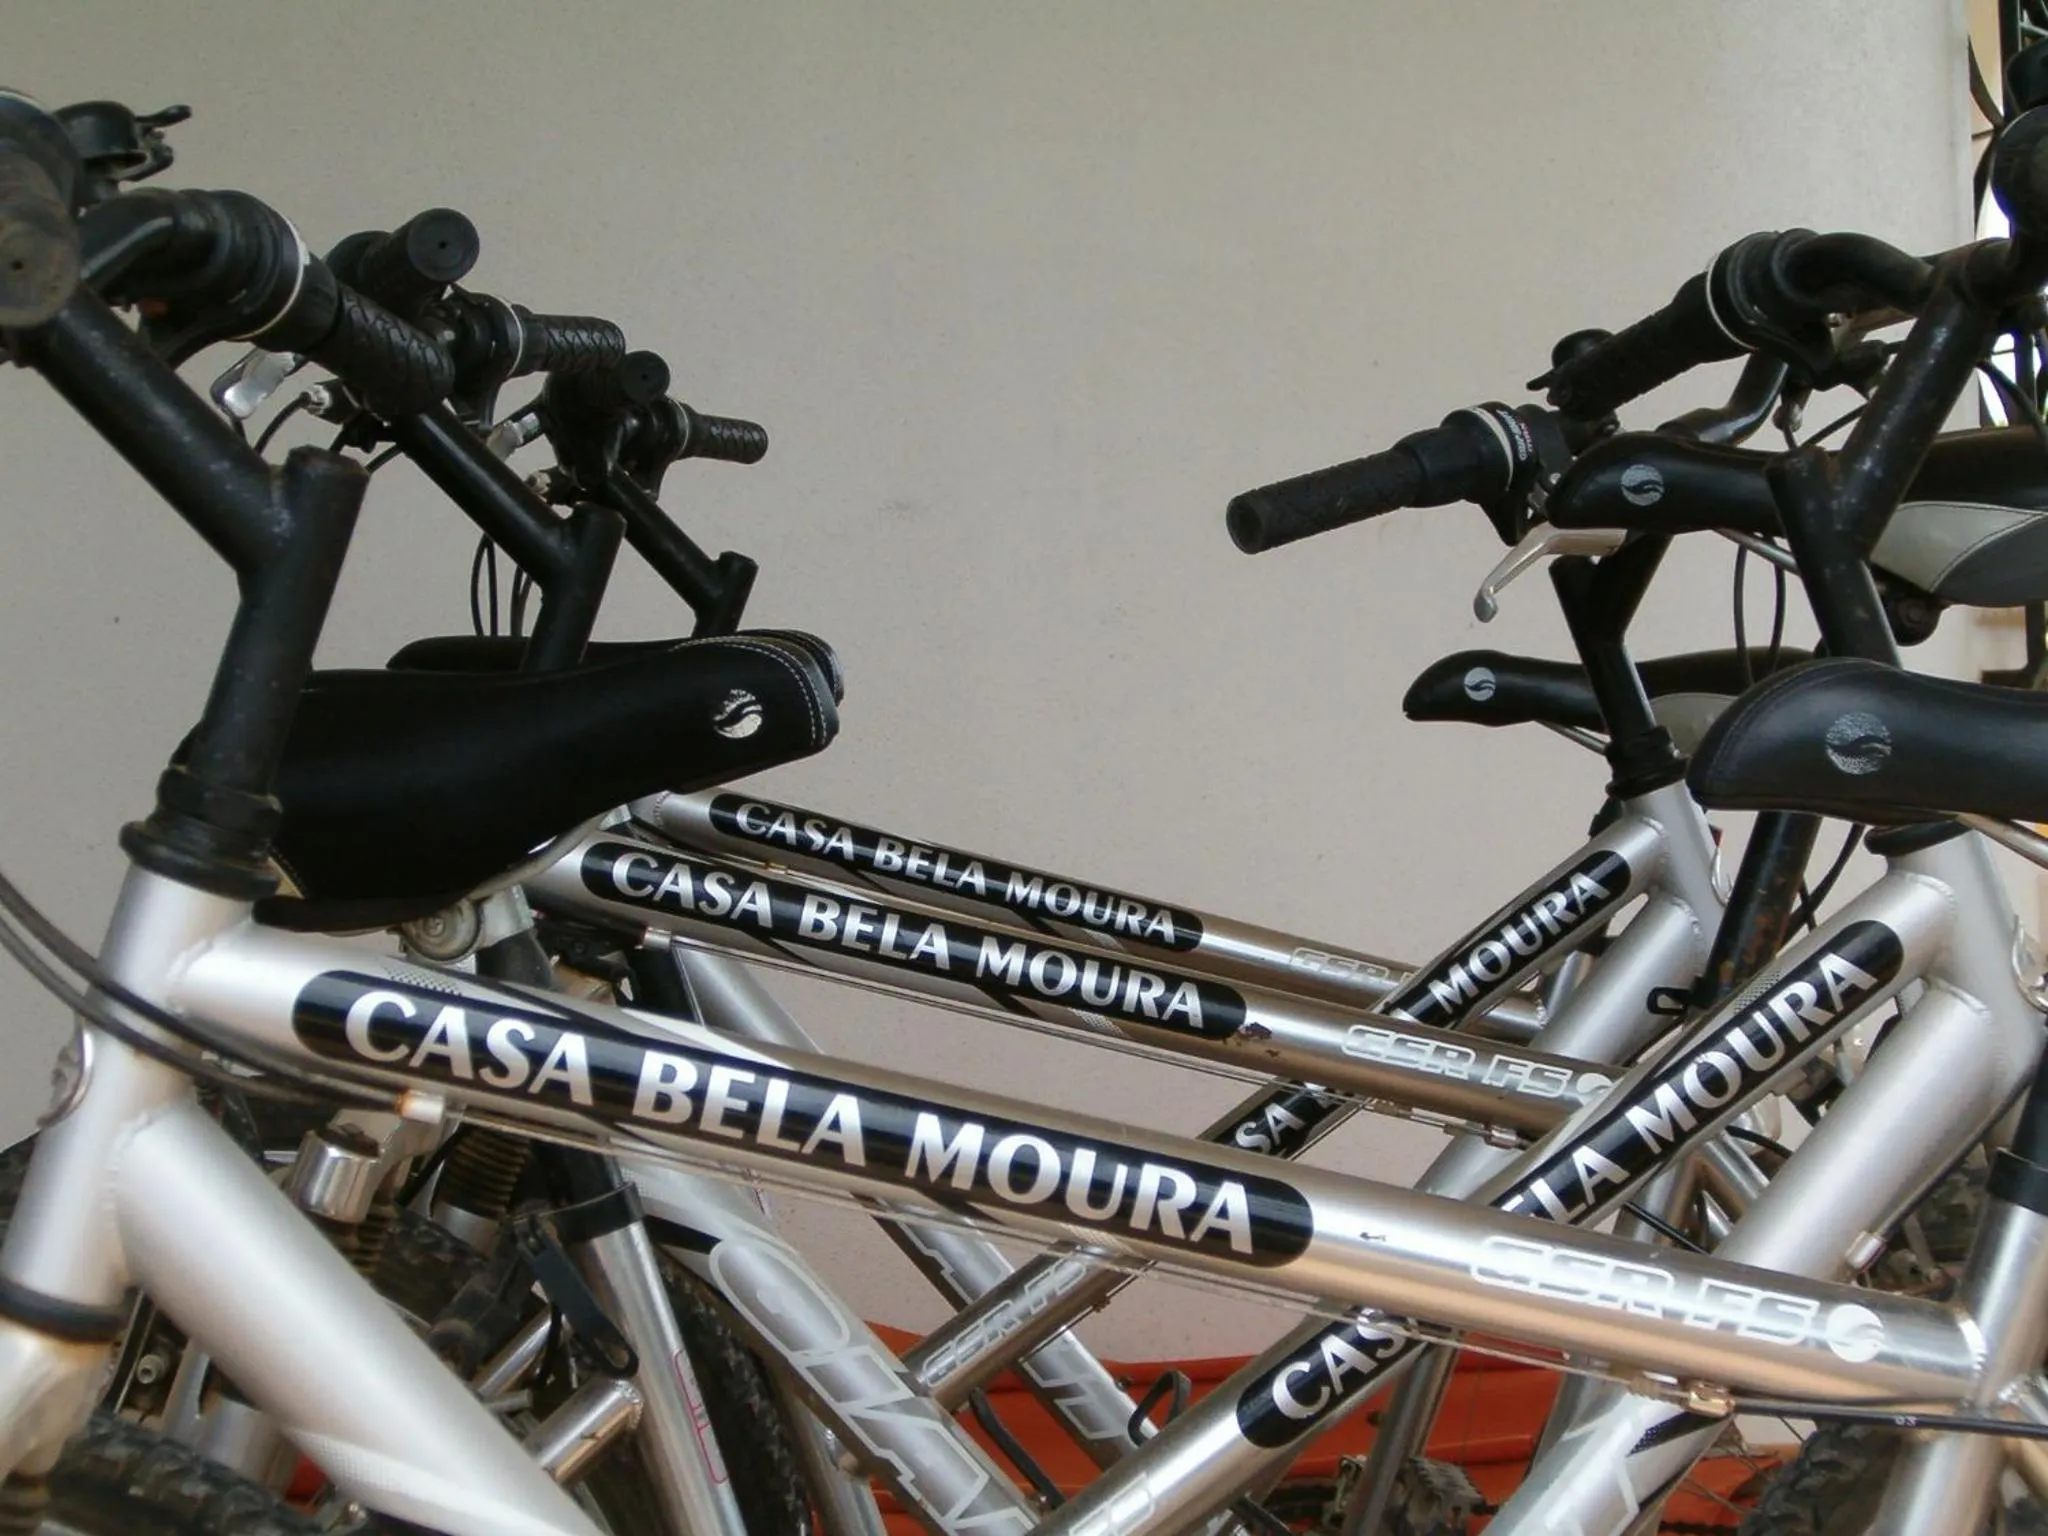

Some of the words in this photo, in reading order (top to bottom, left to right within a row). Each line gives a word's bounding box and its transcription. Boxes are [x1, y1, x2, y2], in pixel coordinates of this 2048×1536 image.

[611, 852, 773, 929] CASA
[797, 893, 951, 971] BELA
[975, 935, 1205, 1029] MOURA
[735, 802, 855, 862] CASA
[872, 836, 987, 897] BELA
[1004, 871, 1177, 945] MOURA
[1427, 871, 1612, 1016] MOURA
[345, 990, 595, 1106] CASA
[631, 1050, 867, 1169] BELA
[903, 1111, 1255, 1256] MOURA
[1234, 1102, 1306, 1155] SA
[1500, 1145, 1631, 1224] LA
[1625, 951, 1878, 1155] MOURA
[1272, 1307, 1420, 1420] CAS
